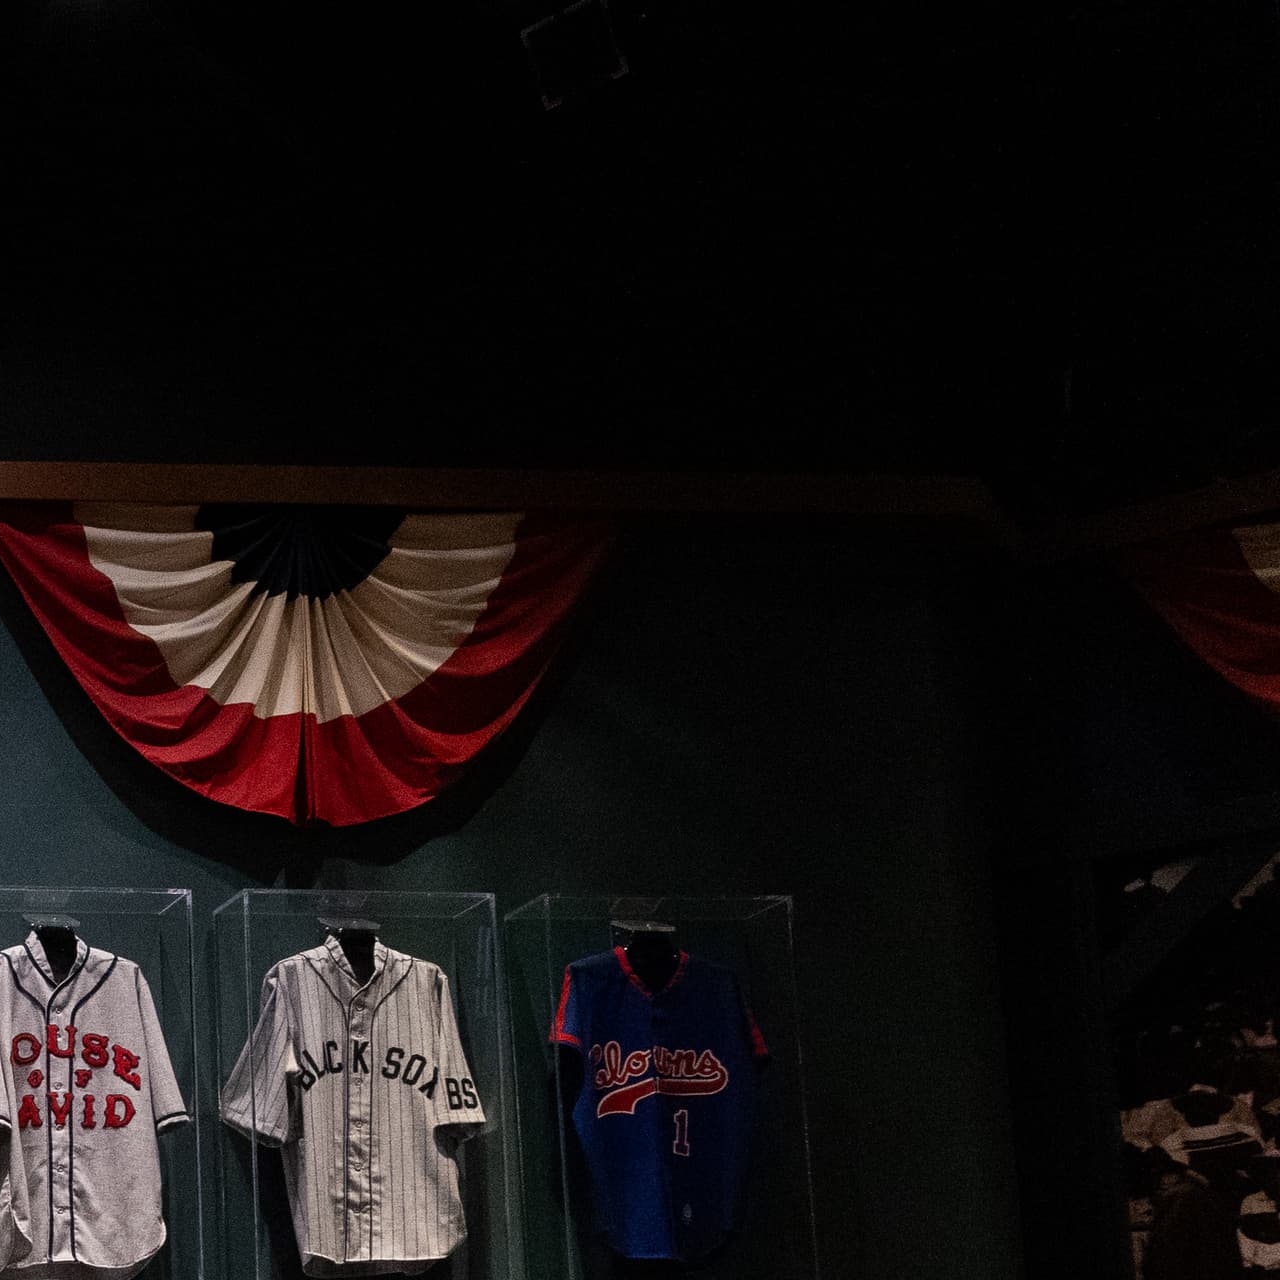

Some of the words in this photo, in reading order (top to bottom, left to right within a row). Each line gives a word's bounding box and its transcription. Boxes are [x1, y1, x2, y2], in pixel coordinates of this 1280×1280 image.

[298, 1040, 369, 1092] BLCK
[445, 1078, 478, 1110] BS
[673, 1109, 690, 1157] 1
